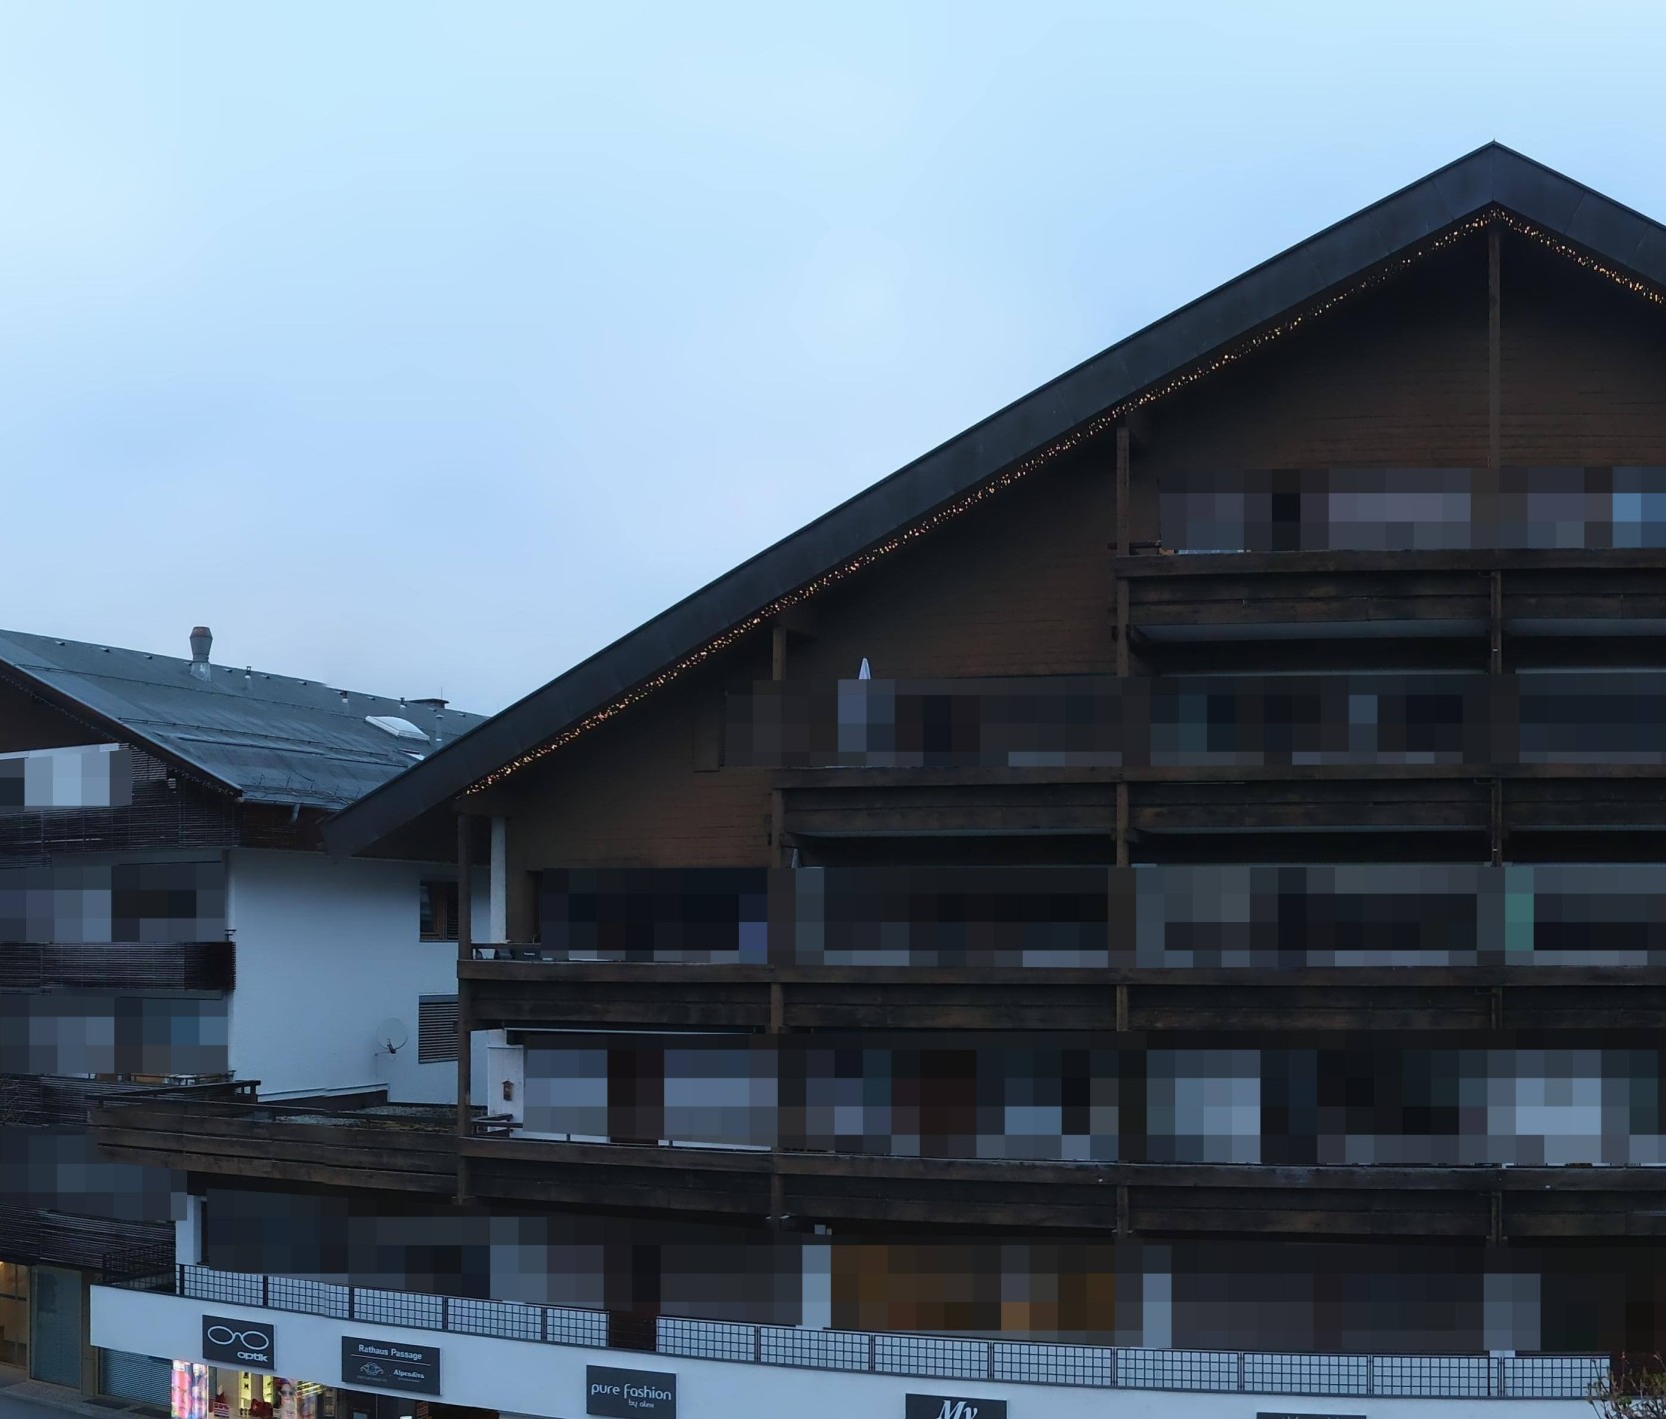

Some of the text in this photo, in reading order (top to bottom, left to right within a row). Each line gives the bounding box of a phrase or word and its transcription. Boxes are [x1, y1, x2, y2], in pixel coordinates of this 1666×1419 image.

[236, 1350, 268, 1363] optik
[358, 1344, 423, 1361] Rathaus Passage
[591, 1382, 672, 1401] pure fashion
